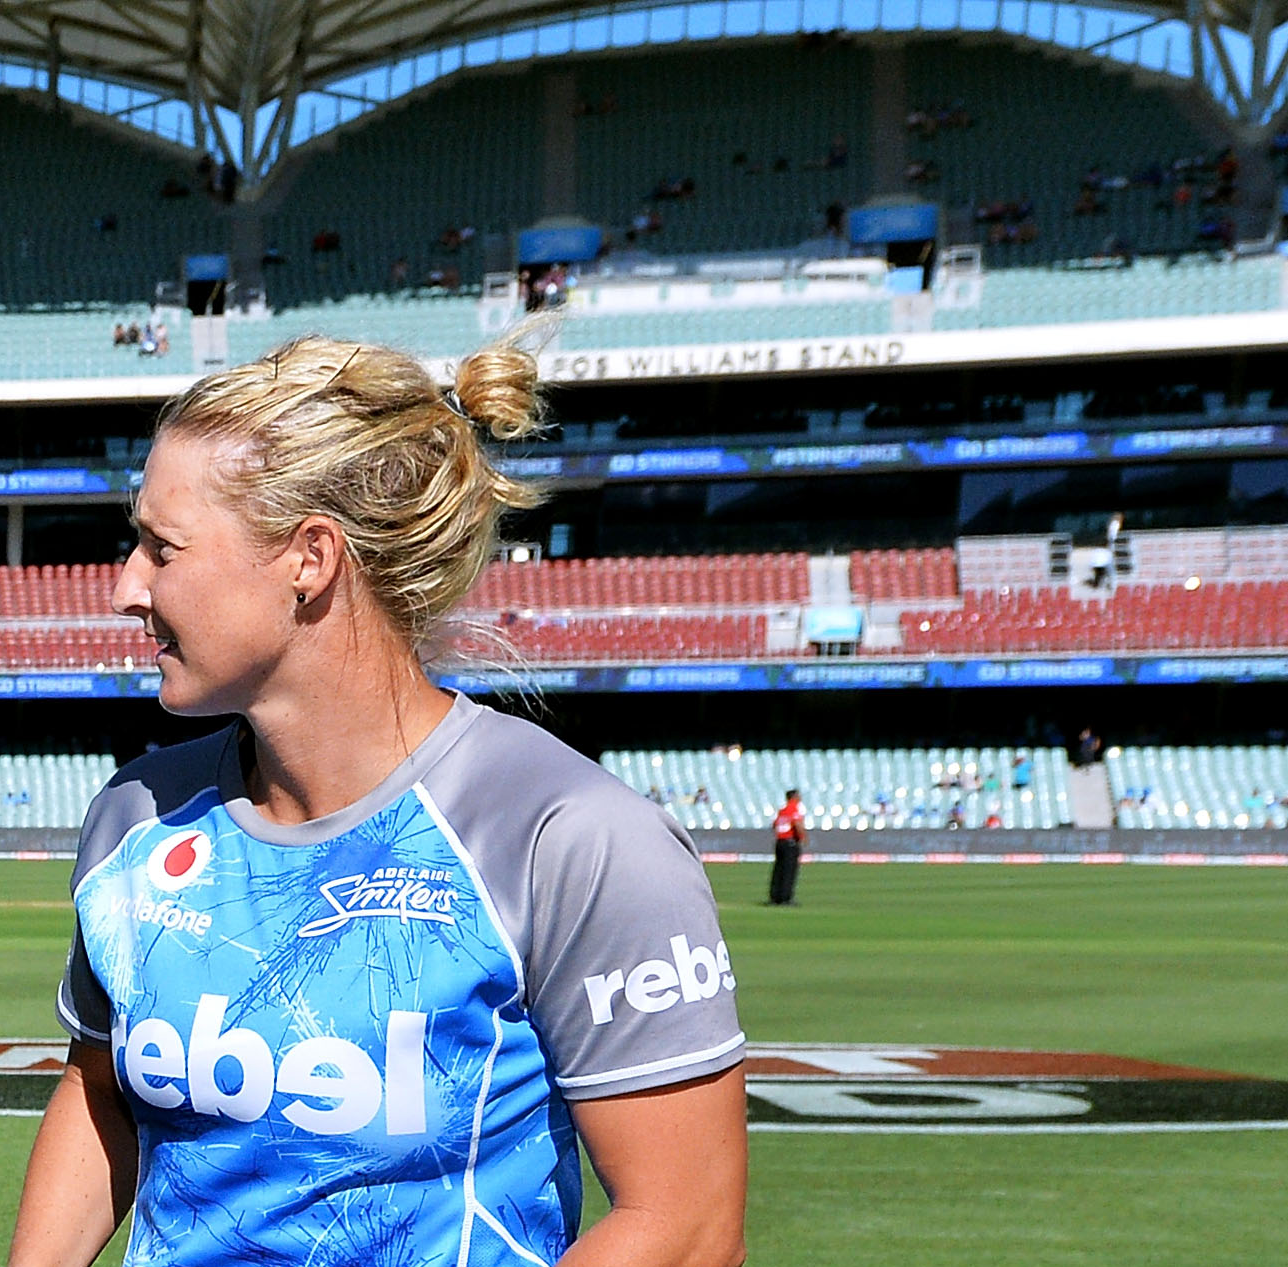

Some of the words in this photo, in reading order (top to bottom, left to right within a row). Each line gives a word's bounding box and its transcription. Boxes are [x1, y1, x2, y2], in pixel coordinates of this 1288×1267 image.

[629, 347, 779, 377] WILLIAMS
[800, 341, 904, 369] STAND
[372, 867, 454, 883] ADELAIDE
